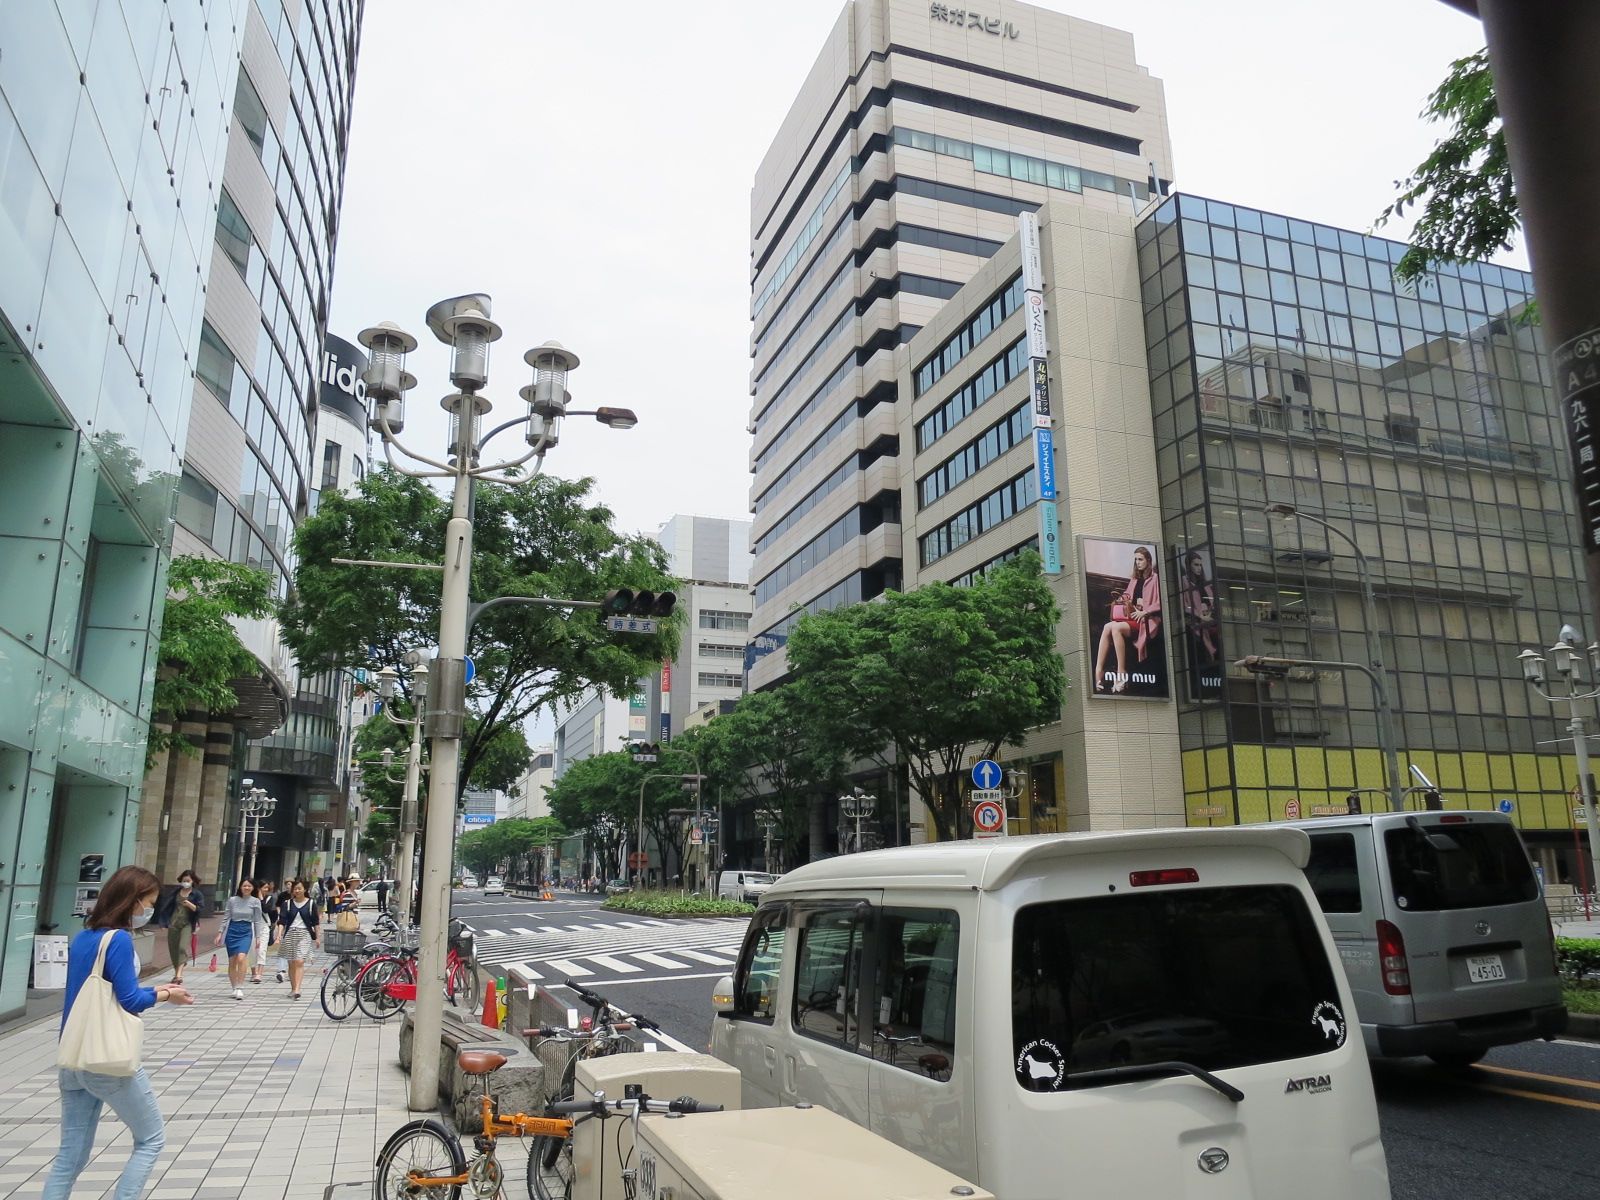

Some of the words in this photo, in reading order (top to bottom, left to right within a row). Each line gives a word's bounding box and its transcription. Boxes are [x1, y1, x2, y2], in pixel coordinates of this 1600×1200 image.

[930, 2, 1020, 39] 栄ガスビル
[613, 619, 651, 631] 時差式
[1105, 671, 1128, 683] miu
[1132, 672, 1156, 684] miu
[1311, 1003, 1324, 1025] English
[1323, 1000, 1342, 1020] Springer
[1336, 1021, 1345, 1047] Spaniel
[1016, 1040, 1038, 1073] American
[1039, 1038, 1062, 1057] Cocker
[1052, 1059, 1066, 1090] Spaniel
[1285, 1075, 1331, 1093] ATRAI
[1309, 1086, 1332, 1095] WAGON
